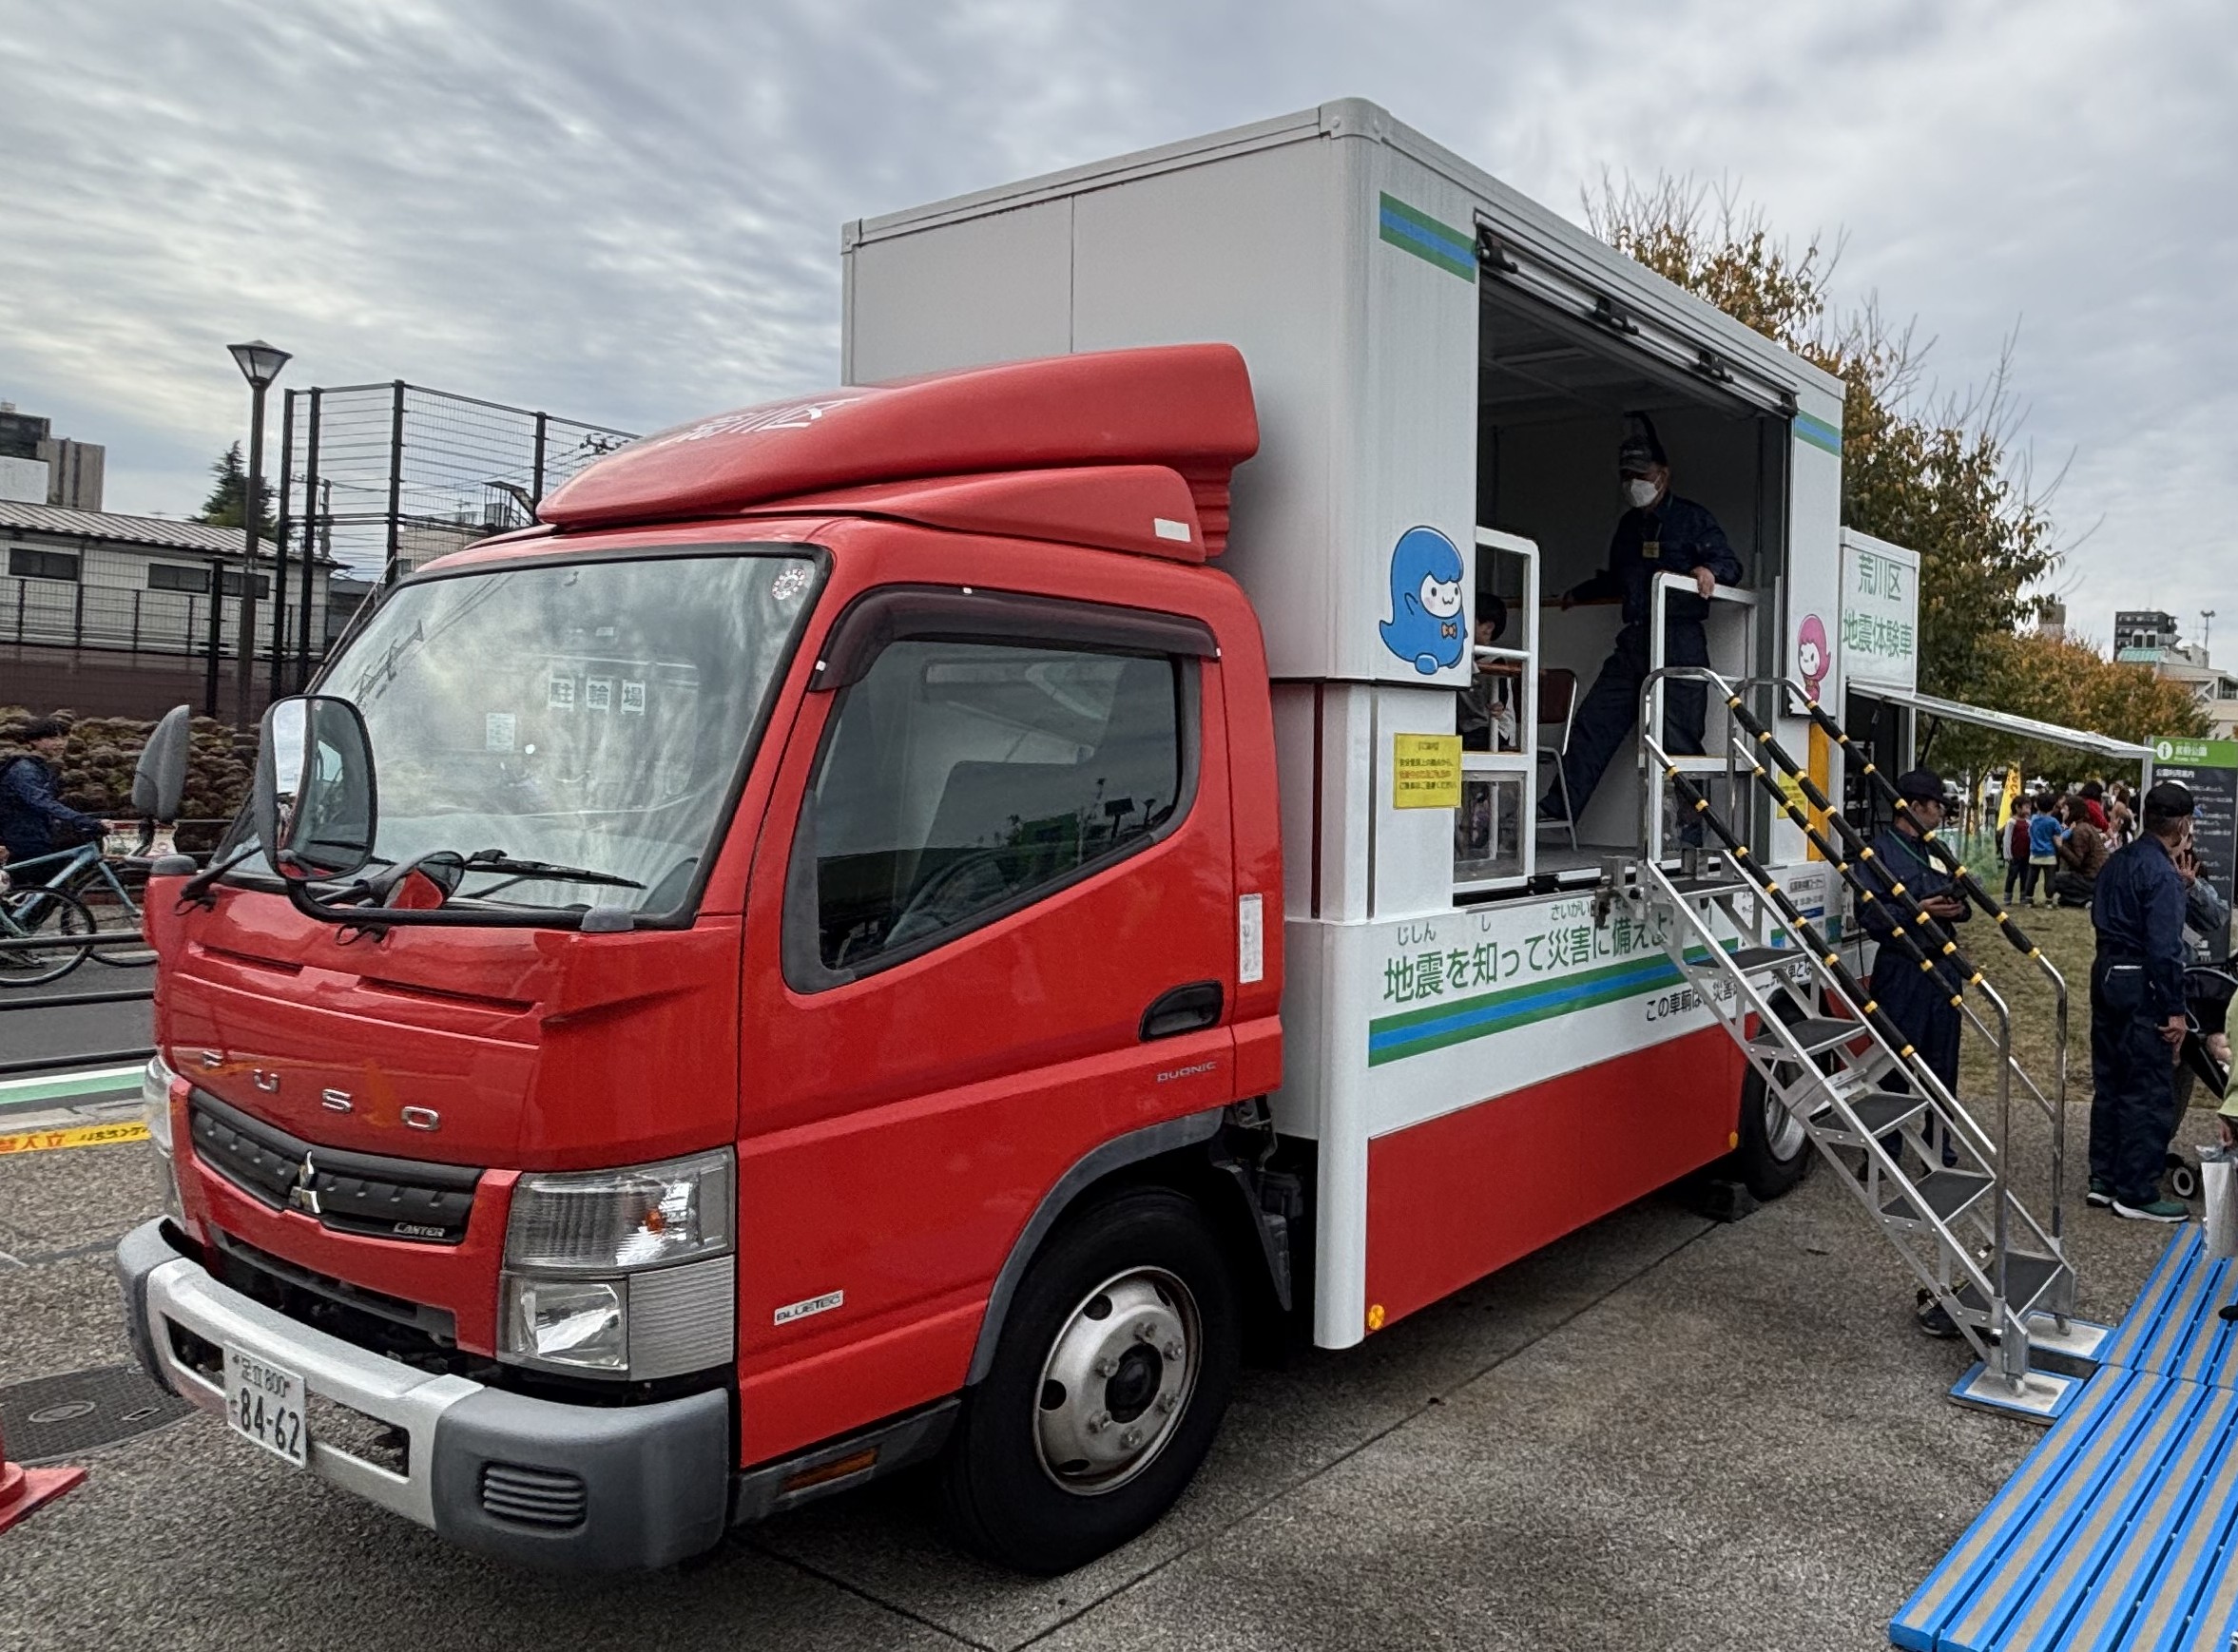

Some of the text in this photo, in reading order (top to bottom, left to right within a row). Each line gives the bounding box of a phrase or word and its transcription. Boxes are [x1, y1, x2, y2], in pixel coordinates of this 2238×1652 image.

[1858, 554, 1901, 602] 荒川区
[1842, 608, 1913, 661] 地震体験車
[1398, 921, 1437, 947] じしん
[1481, 913, 1492, 932] し
[203, 1050, 440, 1131] FUSO
[1157, 1062, 1217, 1083] DUONIC
[776, 1293, 841, 1322] BLUETEC
[241, 1387, 302, 1460] 84-62
